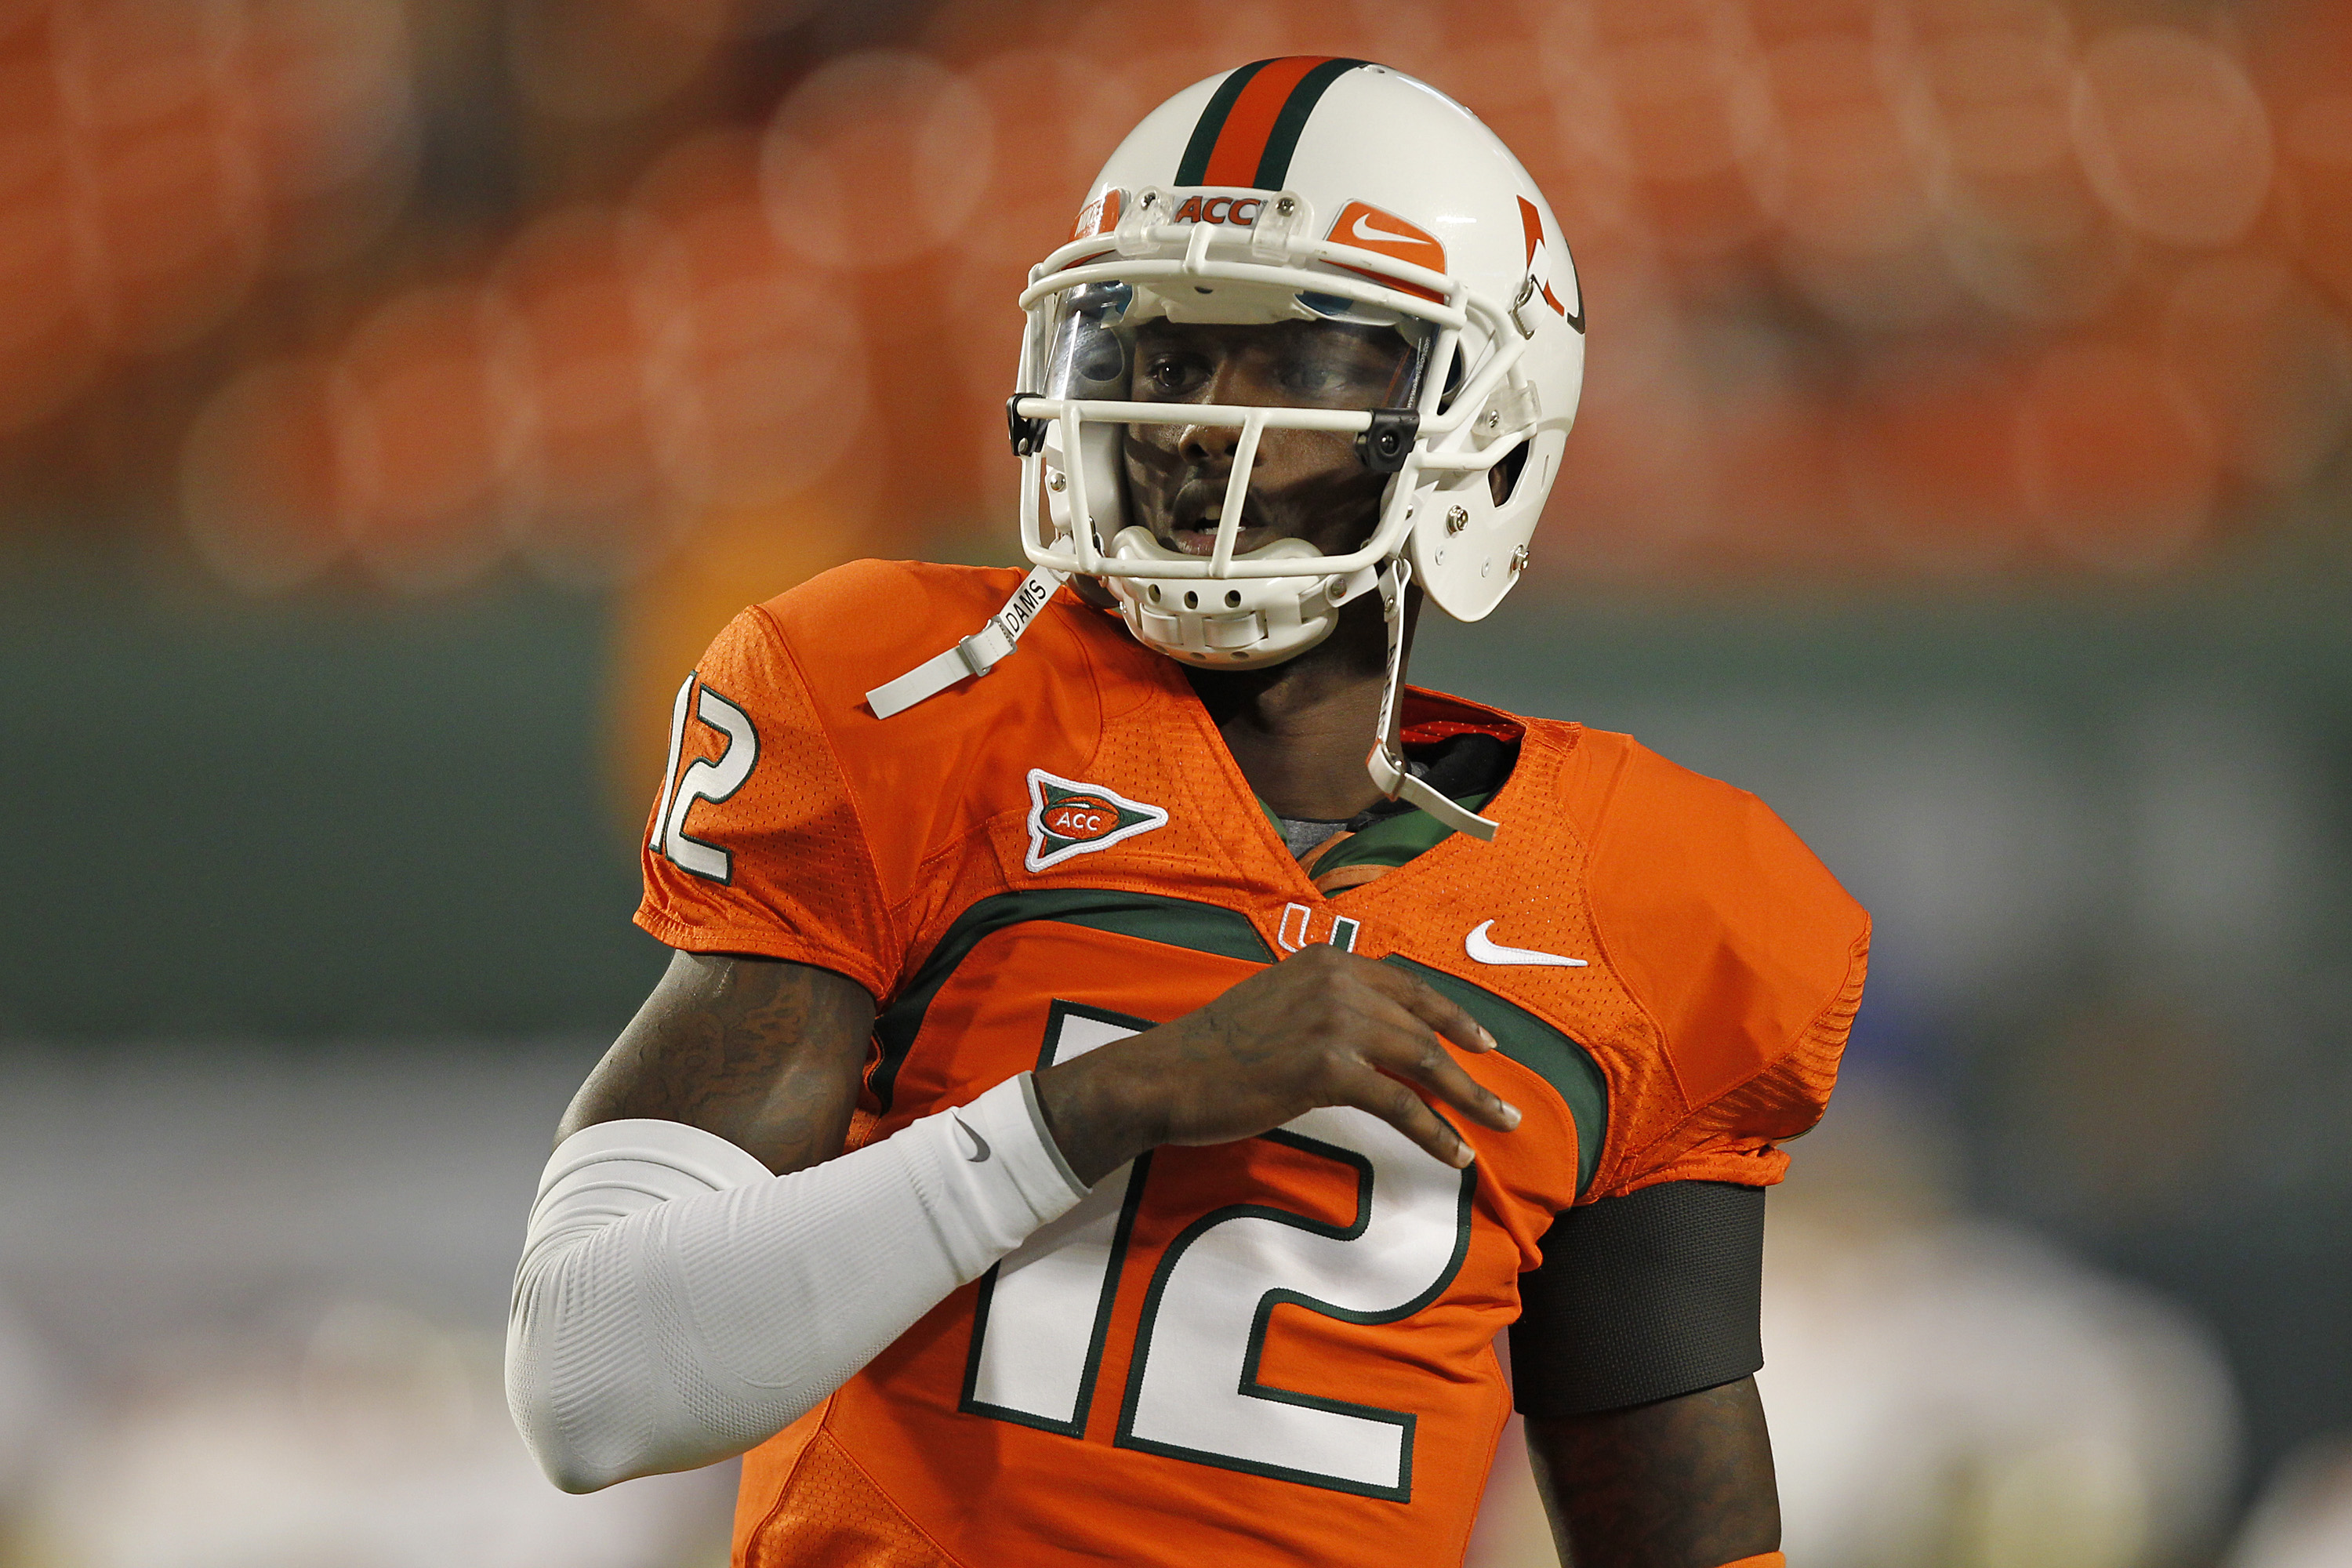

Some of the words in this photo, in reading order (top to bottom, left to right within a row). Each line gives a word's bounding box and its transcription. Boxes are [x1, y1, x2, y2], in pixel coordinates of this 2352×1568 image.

[1174, 195, 1261, 226] ACC
[649, 670, 760, 887] 12
[1055, 811, 1101, 831] ACC
[957, 998, 1477, 1503] 12
